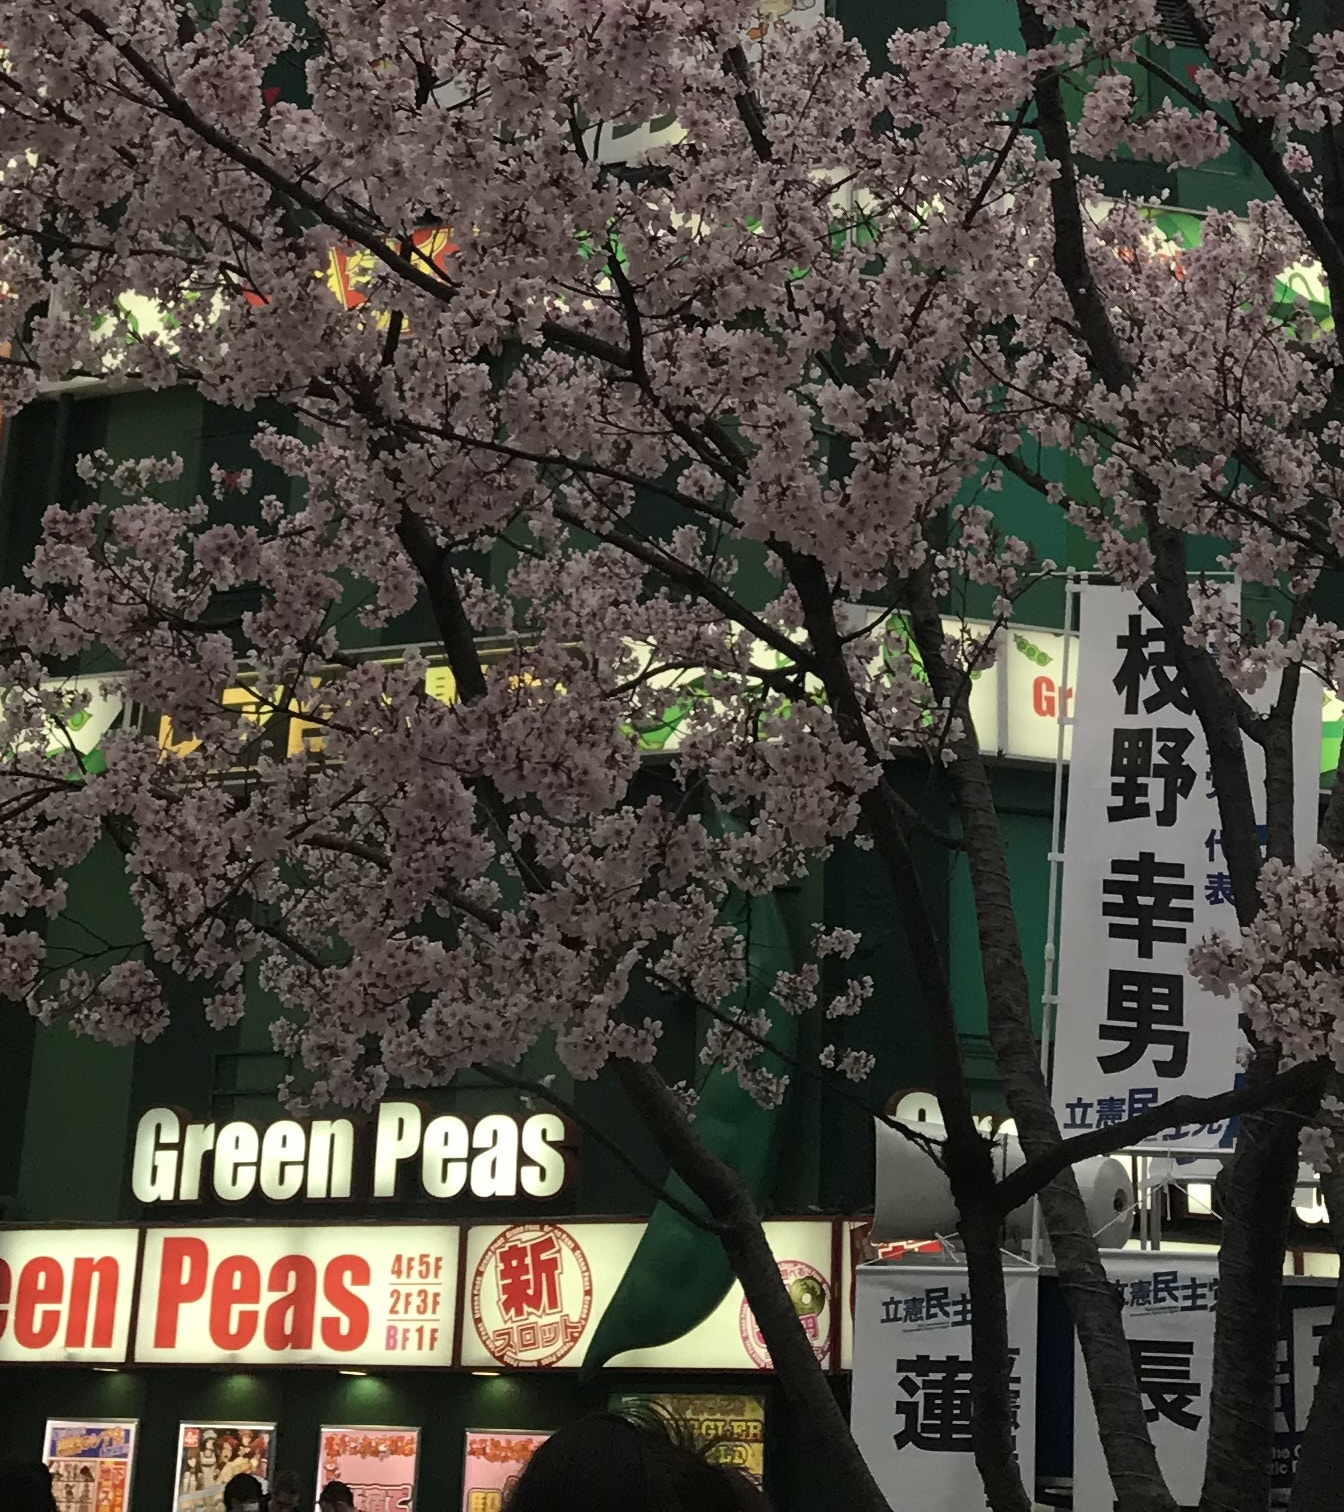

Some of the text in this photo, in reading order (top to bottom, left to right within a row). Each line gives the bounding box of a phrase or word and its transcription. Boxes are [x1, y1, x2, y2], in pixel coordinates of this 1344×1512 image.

[1097, 614, 1195, 1079] 枝野幸男
[131, 1100, 567, 1203] Green Peas
[153, 1235, 371, 1353] Peas
[495, 1235, 562, 1322] 新
[492, 1314, 586, 1356] スロット
